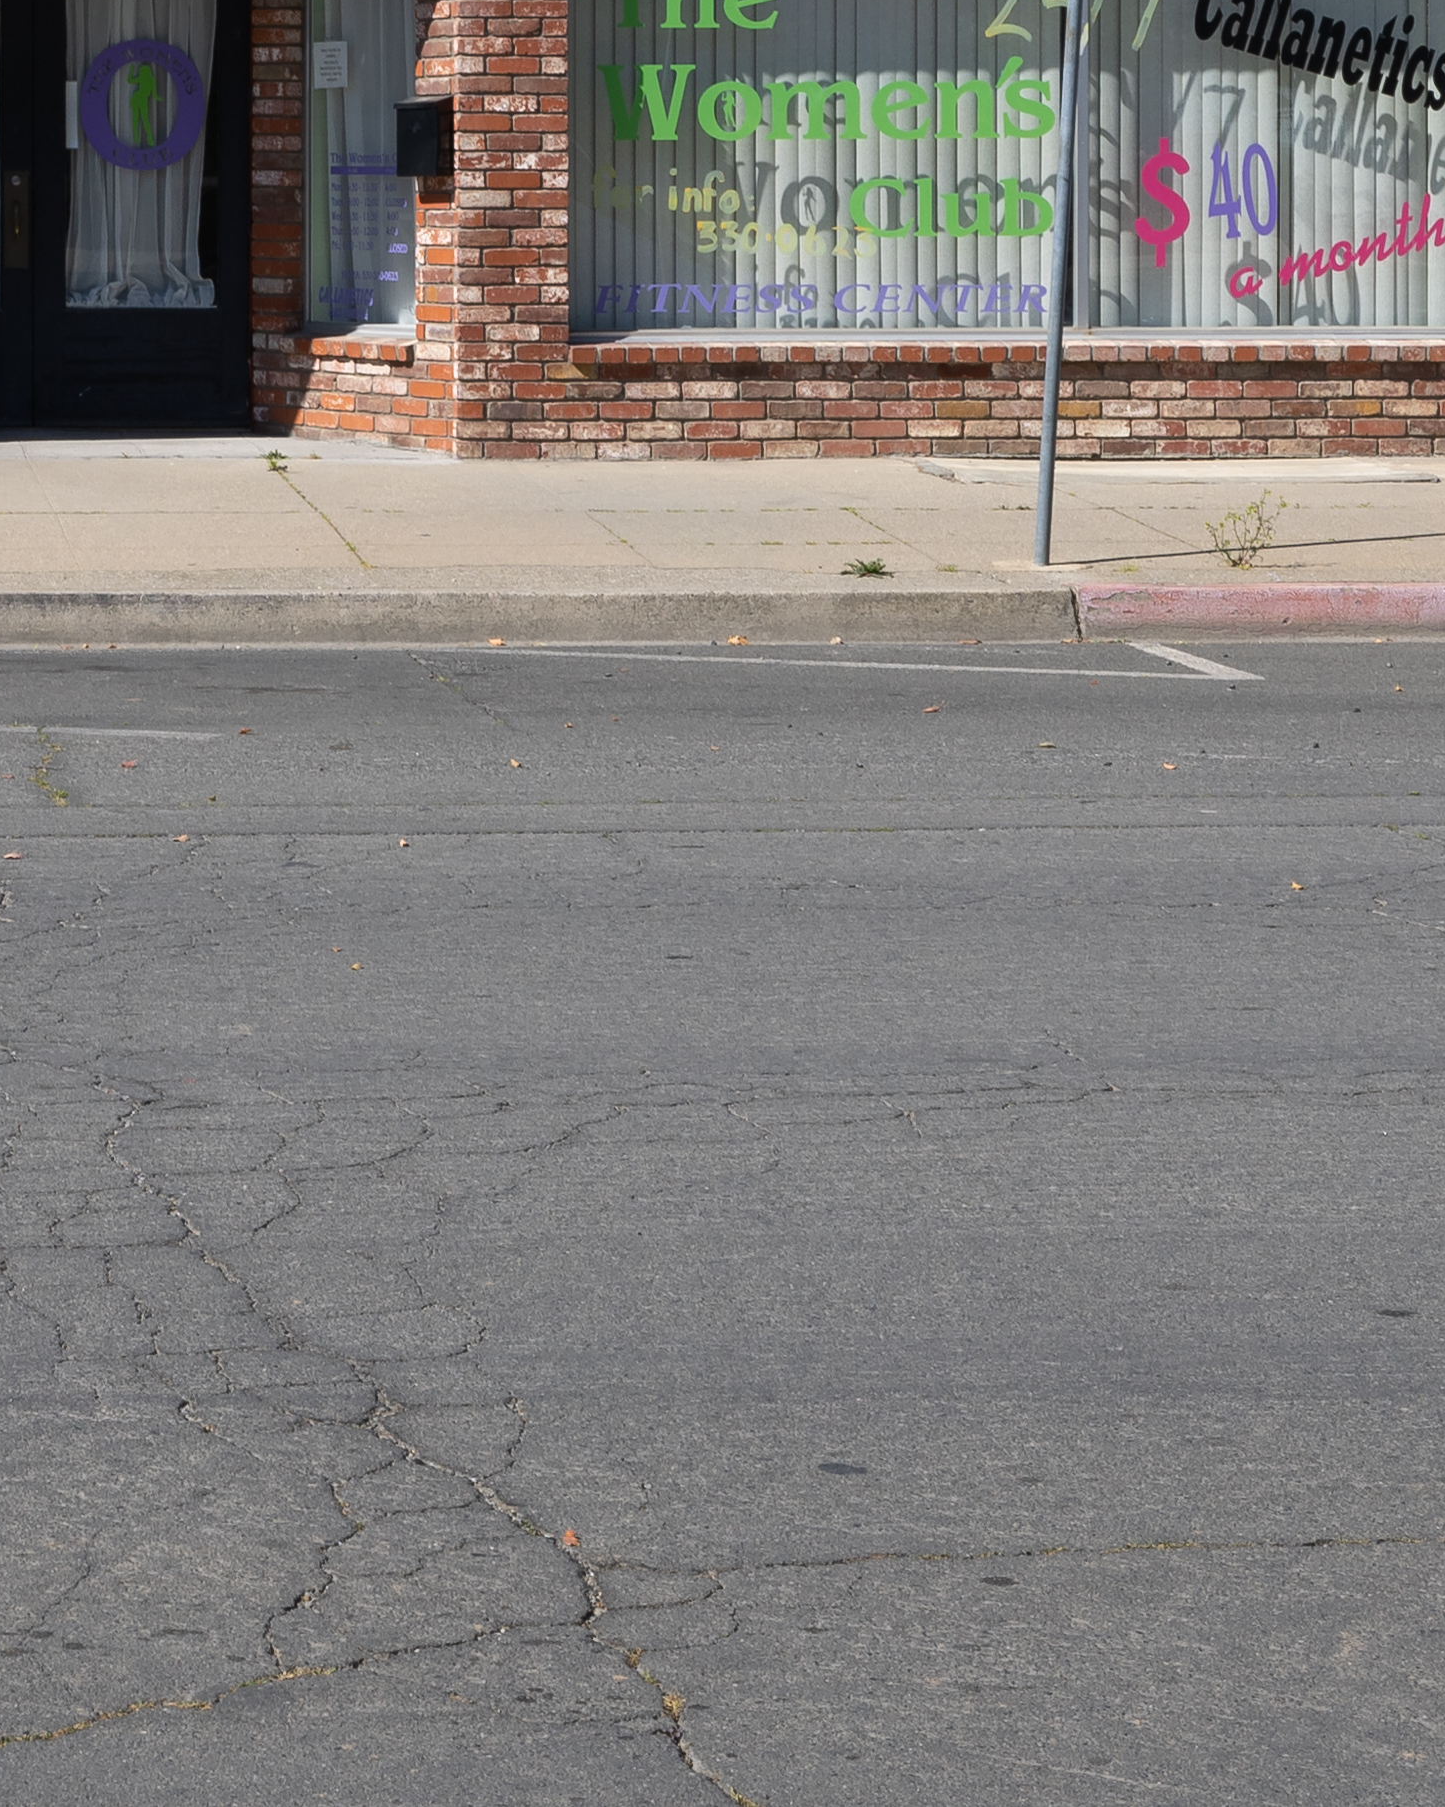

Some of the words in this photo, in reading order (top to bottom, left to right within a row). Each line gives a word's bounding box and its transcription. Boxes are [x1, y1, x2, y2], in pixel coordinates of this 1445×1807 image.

[596, 56, 1057, 142] Women's
[848, 175, 1054, 239] Club
[594, 284, 818, 314] FITNESS
[834, 284, 1049, 314] CENTER
[1229, 265, 1264, 299] a
